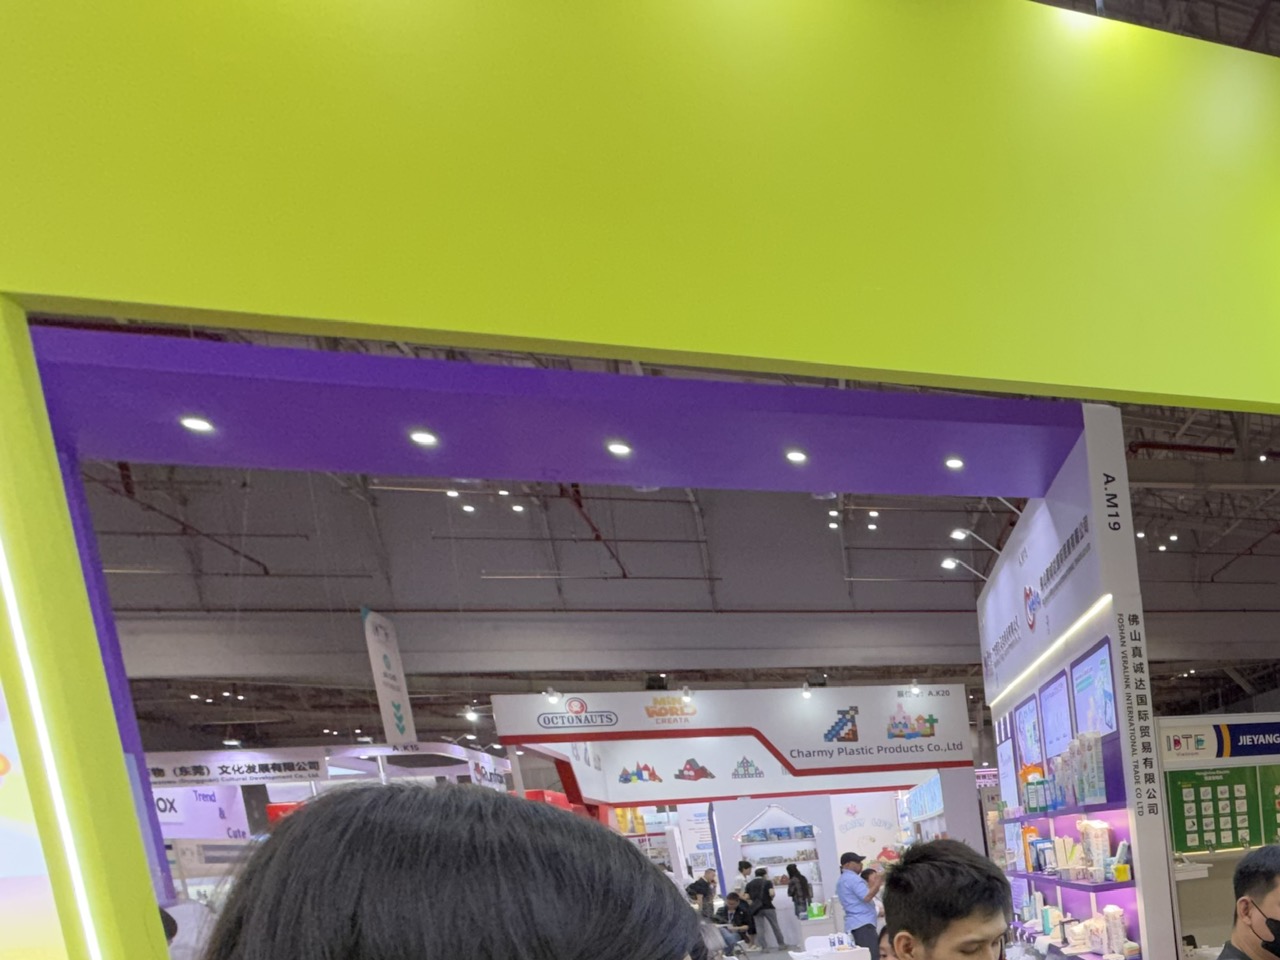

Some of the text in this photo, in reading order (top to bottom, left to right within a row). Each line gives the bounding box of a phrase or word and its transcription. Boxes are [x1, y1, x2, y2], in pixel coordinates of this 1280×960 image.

[1103, 472, 1121, 531] A.M19
[543, 714, 614, 726] OCTONAUTS
[1117, 613, 1144, 817] FOSHAN VERALINK INTERNATIONAL TRADE CO LTD
[1128, 613, 1159, 816] 佛山真诚达国际贸易有限公司
[1238, 733, 1280, 746] JIEYANG
[789, 741, 963, 760] Charmy Plastic Products Co.,Ltd
[193, 790, 217, 802] Trend
[156, 797, 178, 814] OX
[227, 827, 247, 839] Cute
